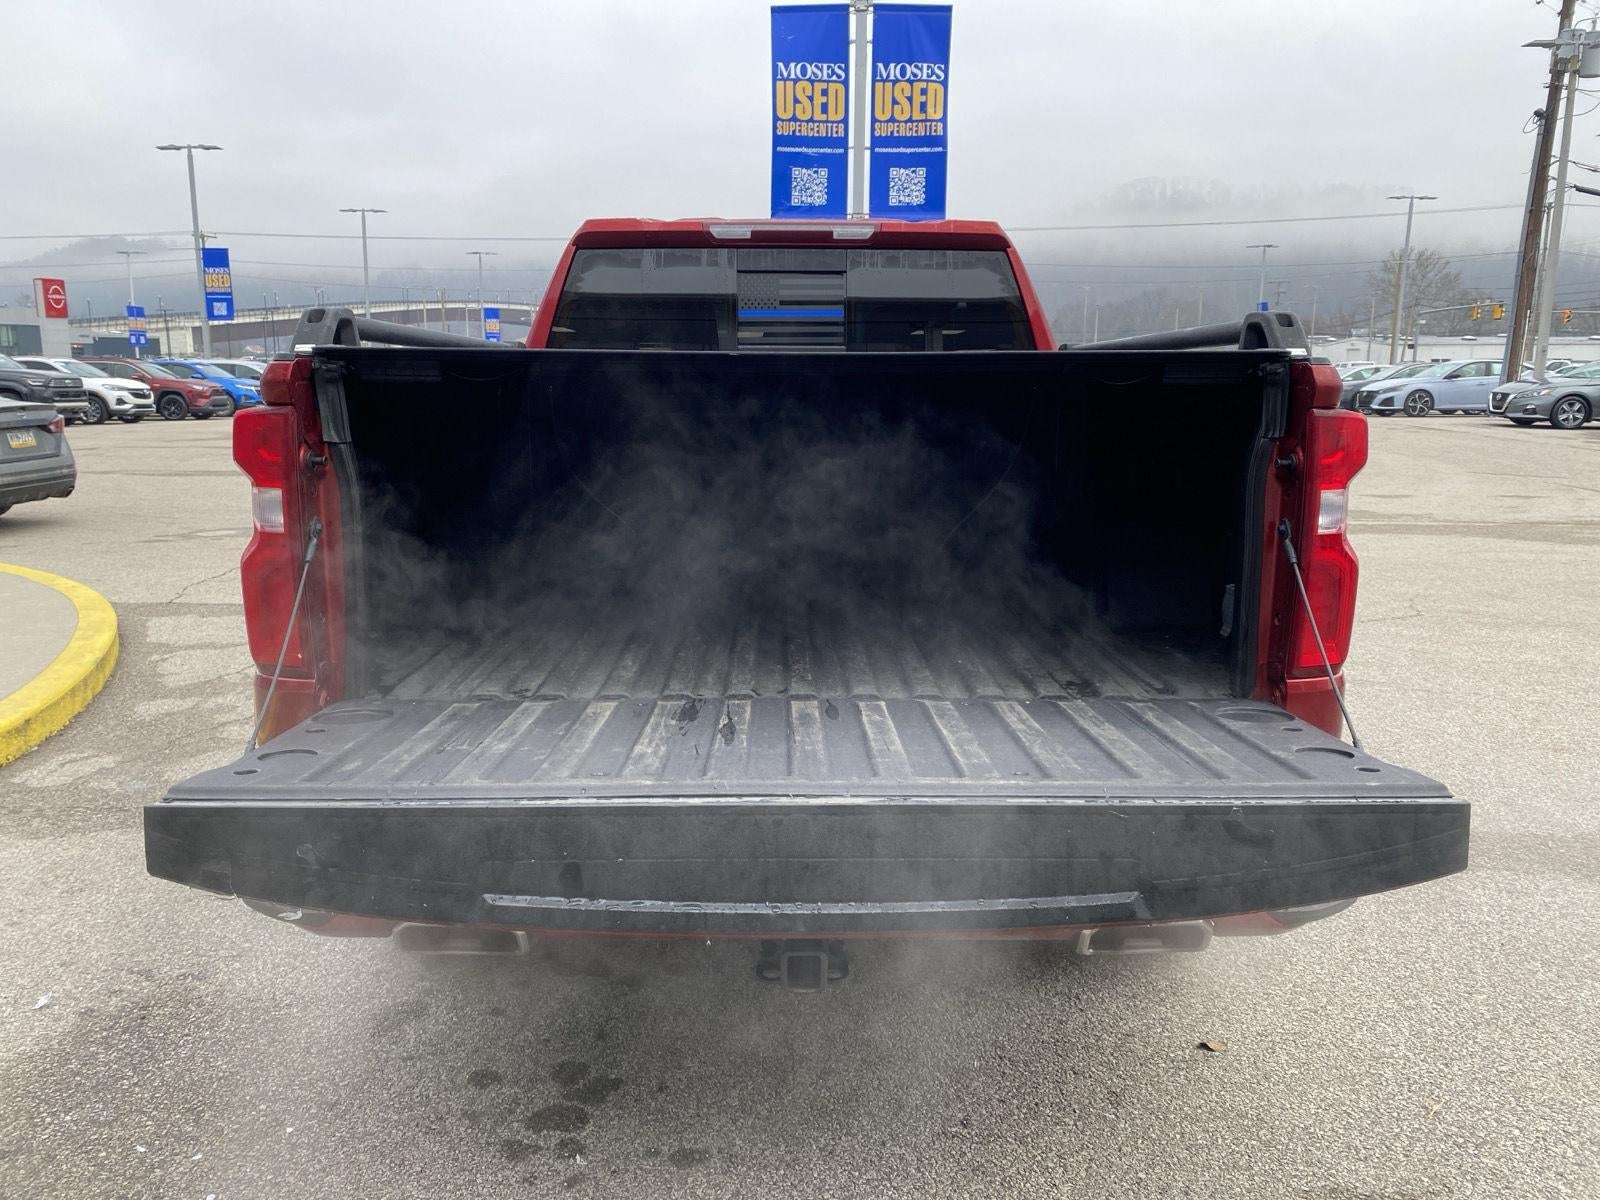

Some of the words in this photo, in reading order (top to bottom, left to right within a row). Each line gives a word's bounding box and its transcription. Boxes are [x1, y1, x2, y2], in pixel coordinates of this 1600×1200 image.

[776, 62, 845, 80] MOSES
[876, 62, 944, 80] MOSES
[776, 80, 845, 121] USED
[874, 81, 944, 121] USED
[776, 121, 844, 137] SUPERCENTER
[874, 122, 943, 137] SUPERCENTER
[205, 274, 231, 287] USED
